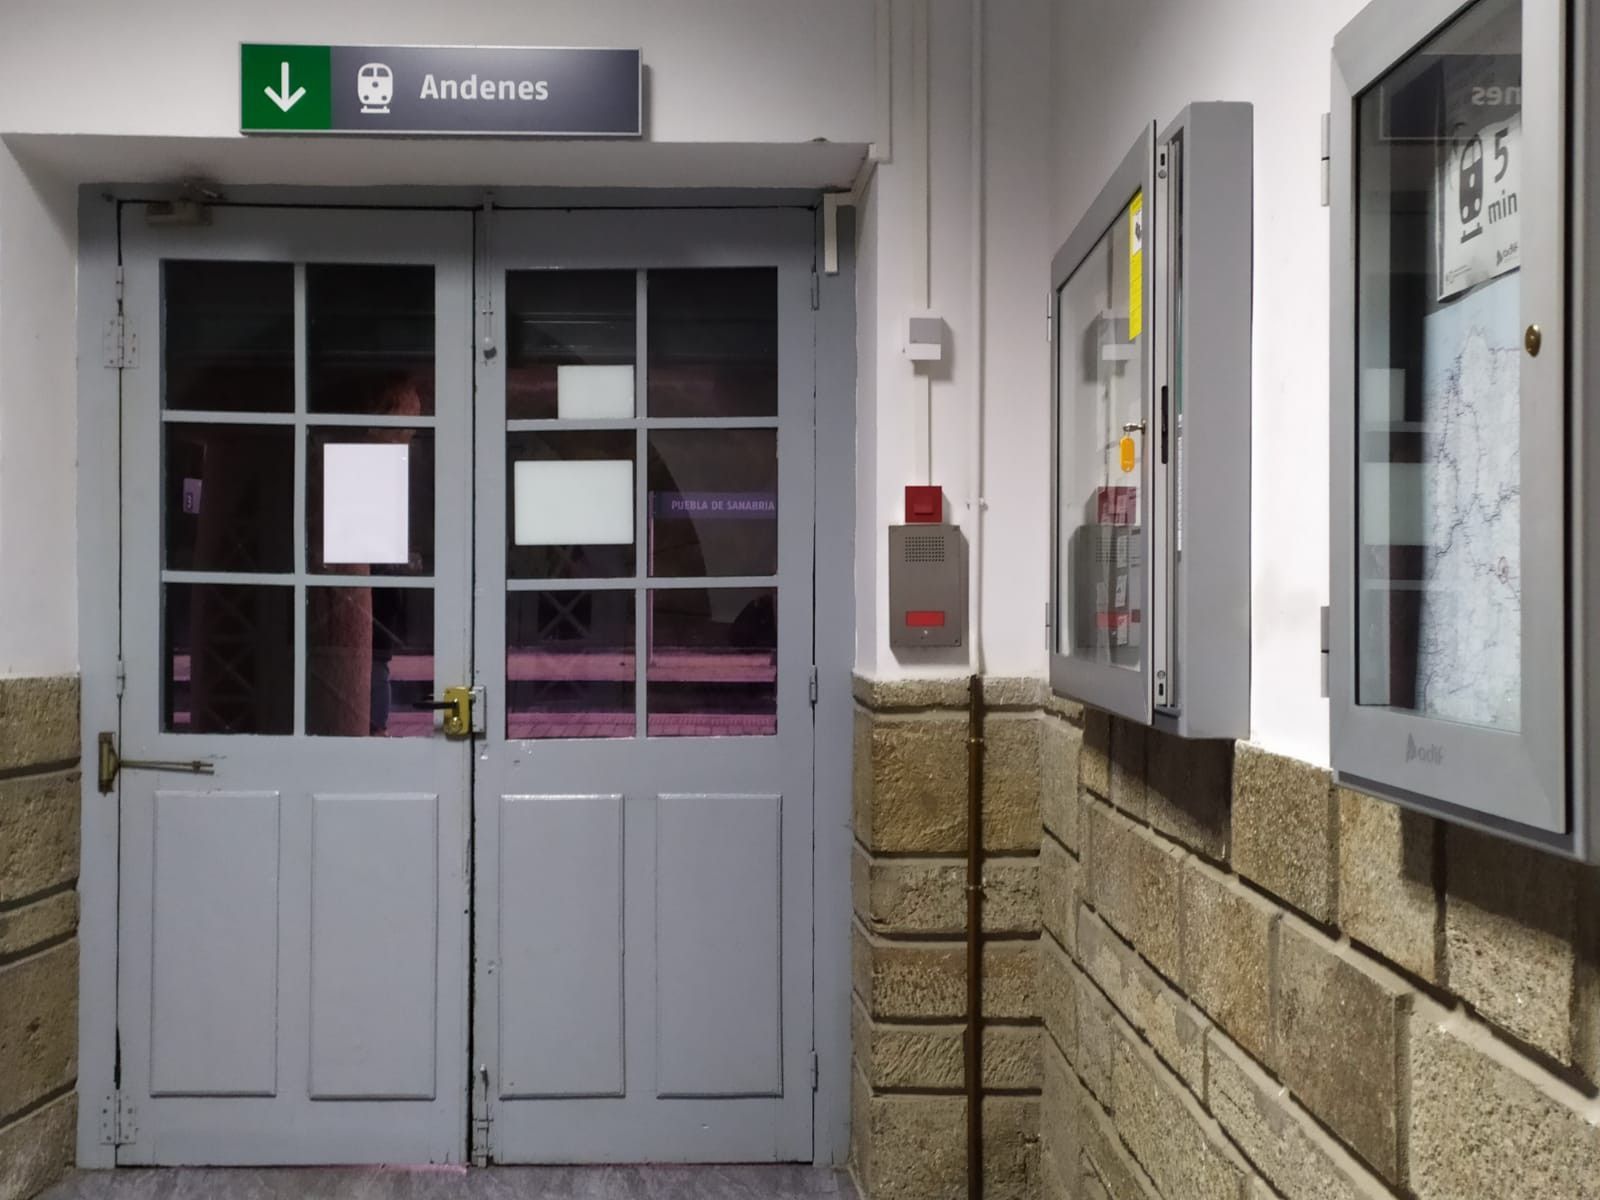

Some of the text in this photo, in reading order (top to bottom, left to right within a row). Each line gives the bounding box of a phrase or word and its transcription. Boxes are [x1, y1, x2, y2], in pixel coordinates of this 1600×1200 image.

[420, 74, 549, 101] Andenes
[1494, 127, 1508, 184] 5
[1488, 189, 1518, 225] min
[671, 500, 775, 511] PUEBLA DE SANABRIA
